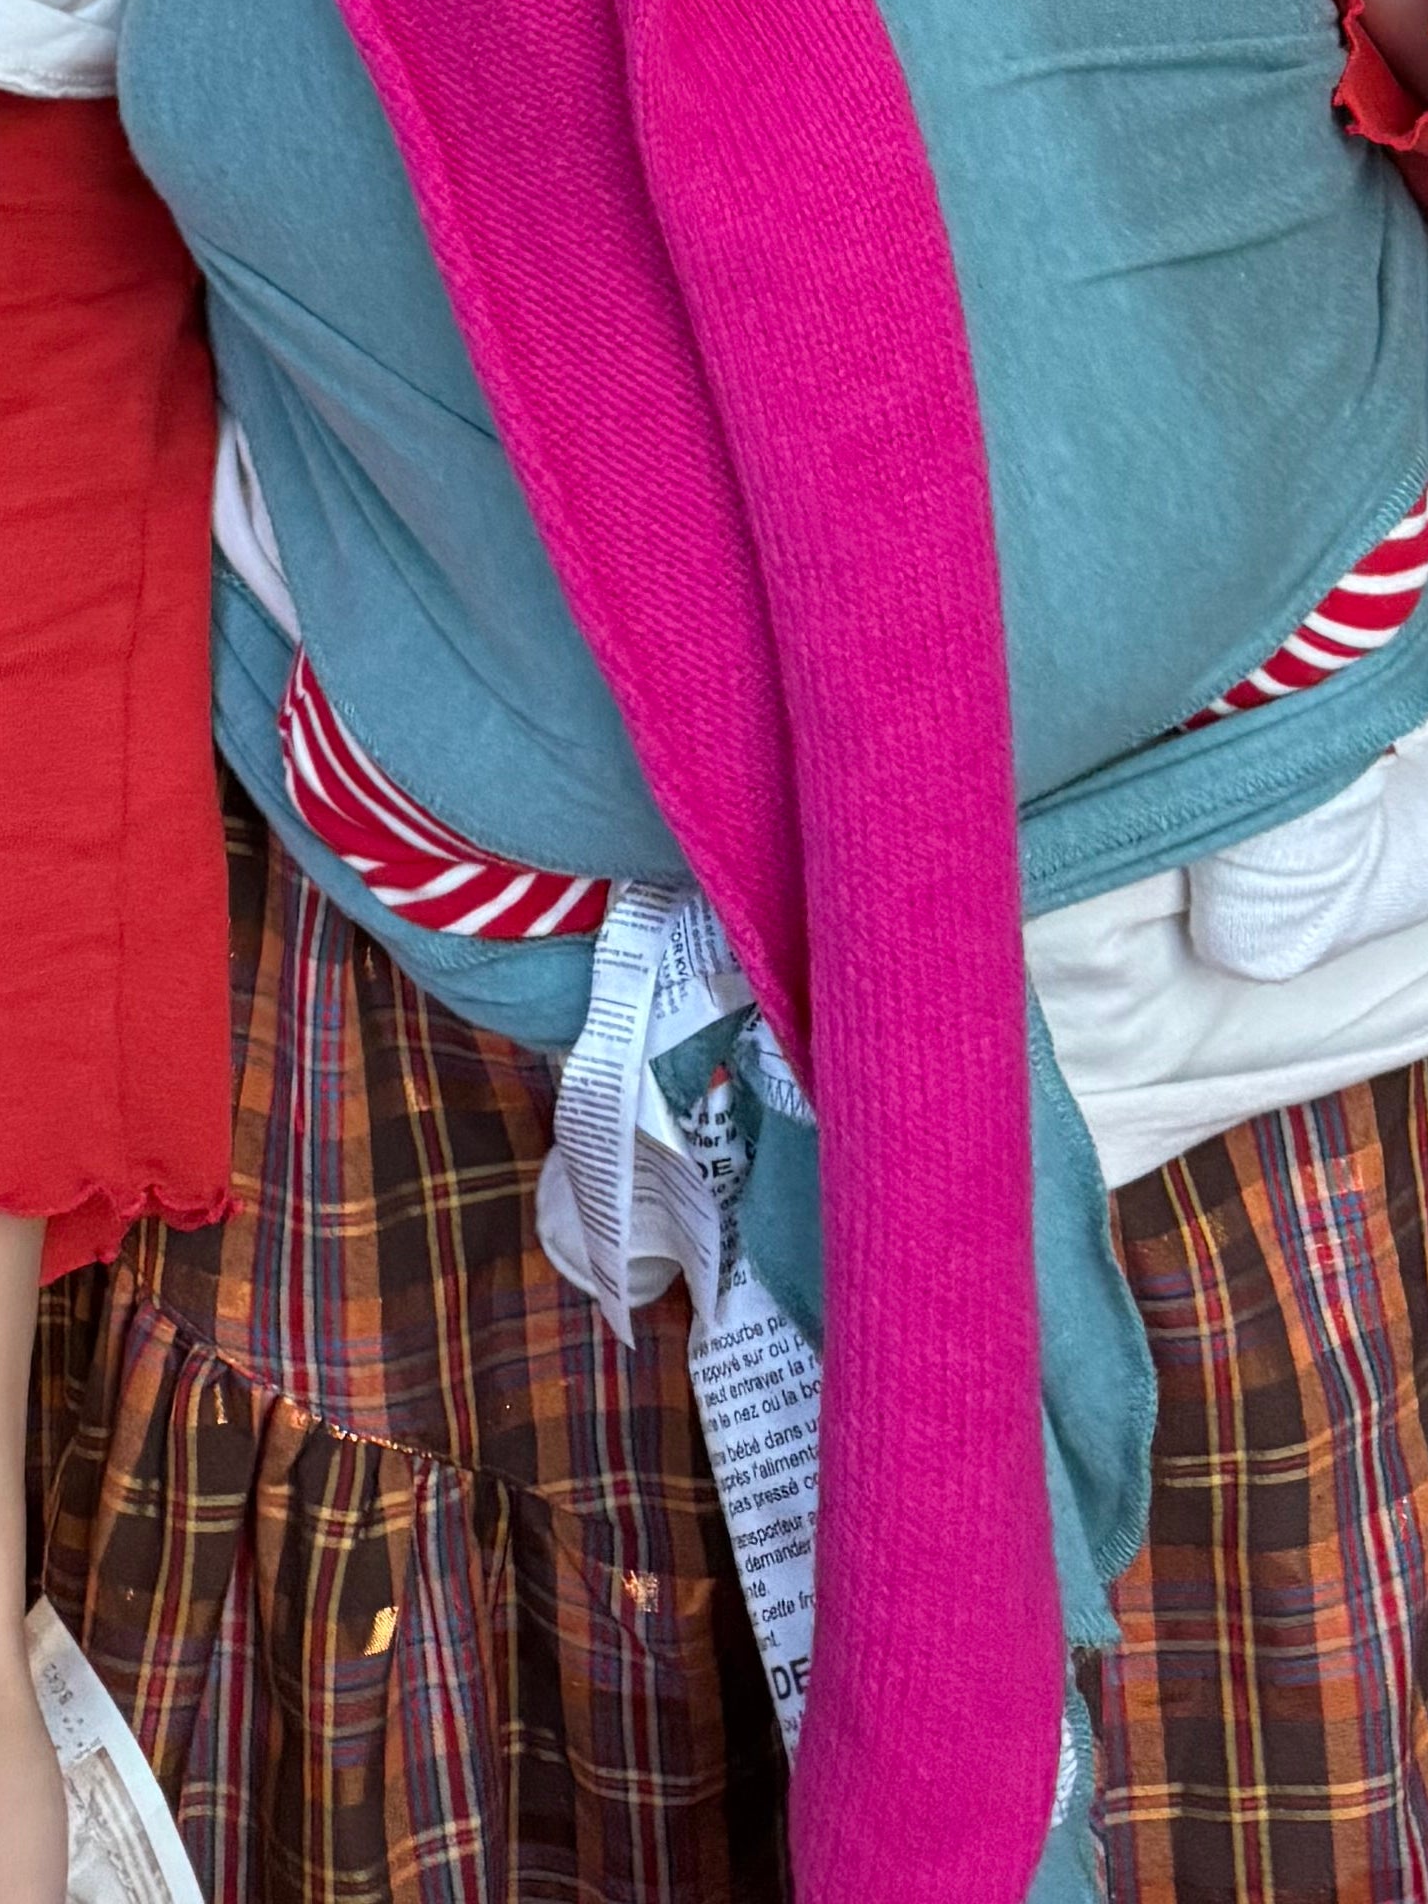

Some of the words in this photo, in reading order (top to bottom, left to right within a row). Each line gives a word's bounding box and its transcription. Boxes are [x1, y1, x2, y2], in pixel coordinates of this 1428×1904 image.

[743, 1348, 763, 1368] sur
[730, 1367, 784, 1399] entraver
[787, 1360, 805, 1377] la
[734, 1405, 760, 1425] nez
[762, 1394, 780, 1414] ou
[781, 1389, 798, 1407] la
[764, 1424, 803, 1450] dans
[729, 1496, 752, 1520] pas
[753, 1476, 800, 1511] pressé
[745, 1536, 812, 1573] demander
[762, 1597, 796, 1622] cette
